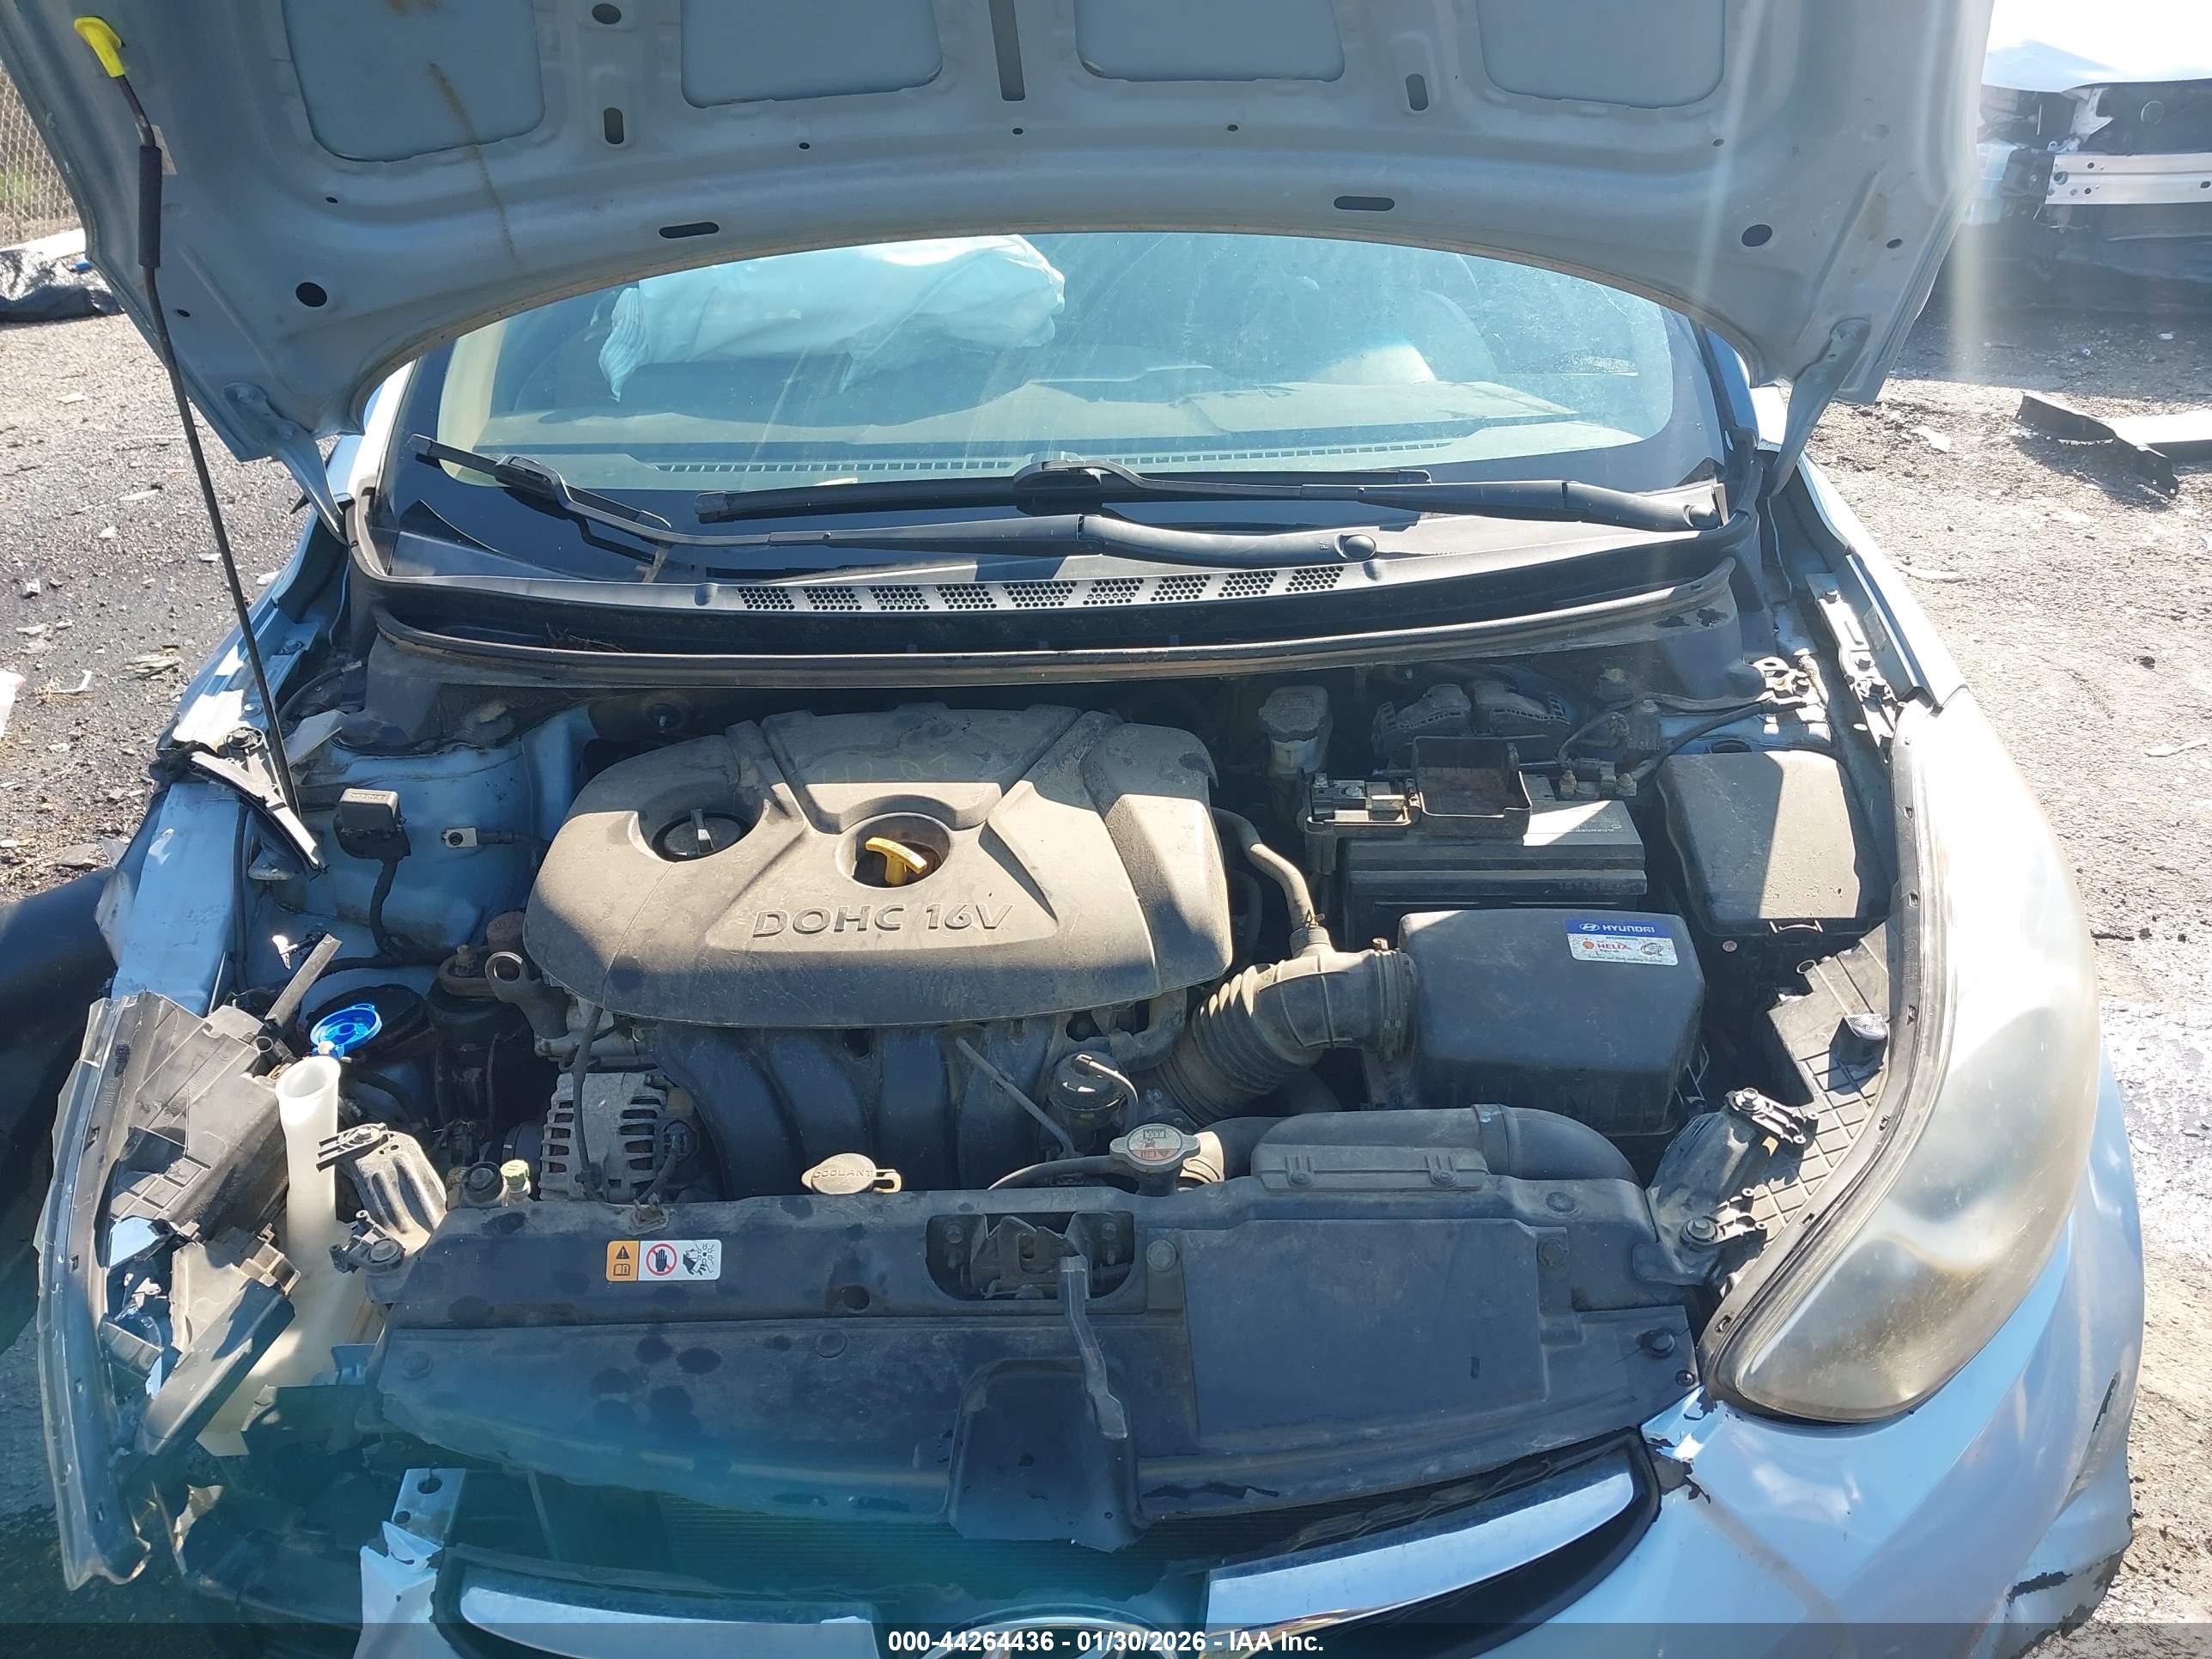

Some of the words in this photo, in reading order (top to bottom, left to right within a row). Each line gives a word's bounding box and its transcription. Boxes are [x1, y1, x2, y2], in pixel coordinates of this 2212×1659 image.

[752, 904, 905, 938] DOHC
[926, 903, 1012, 930] 16V
[1601, 924, 1656, 933] HYUNDAI
[812, 1169, 874, 1179] COOLANT
